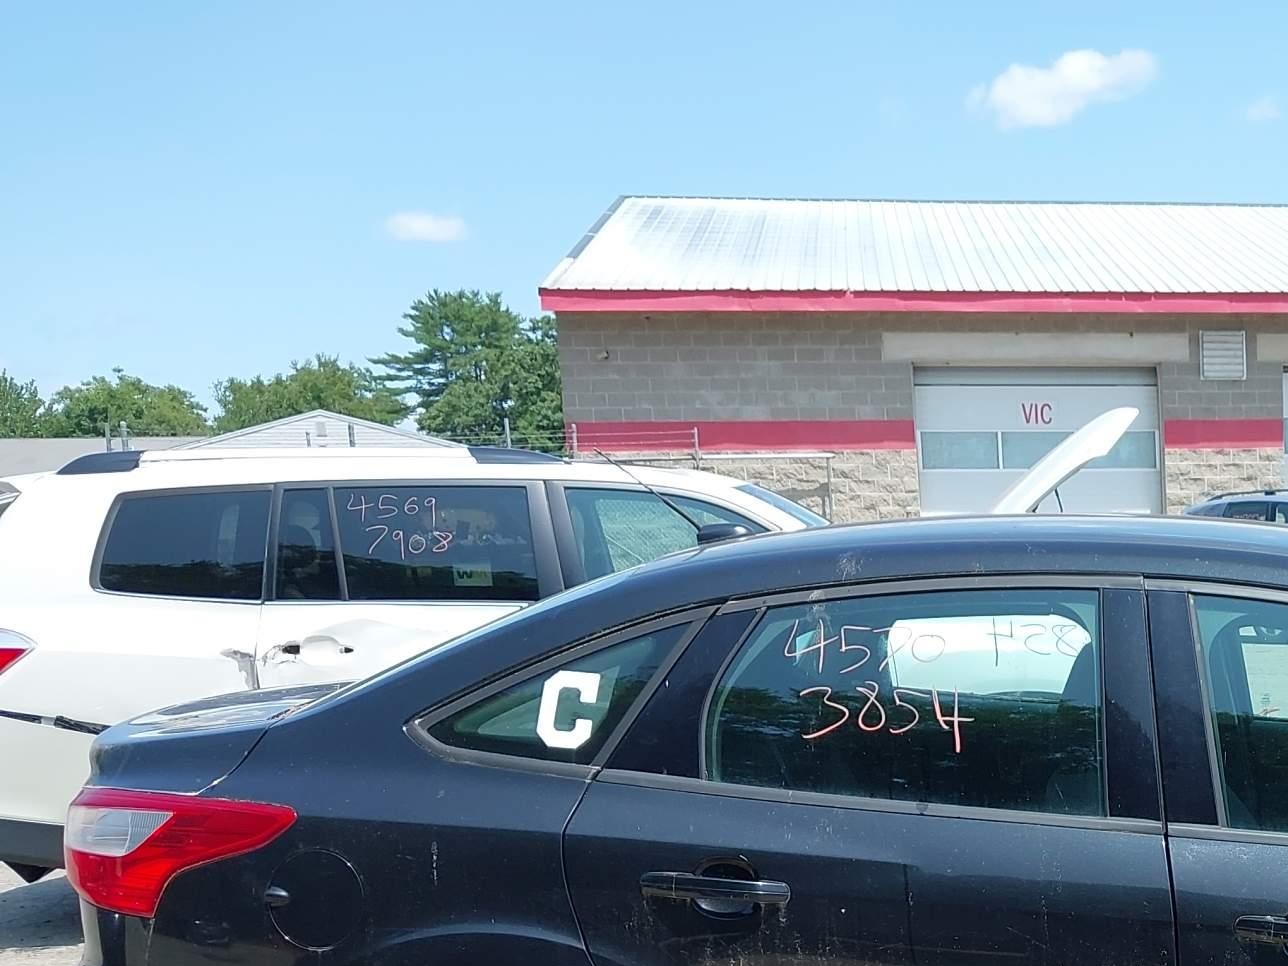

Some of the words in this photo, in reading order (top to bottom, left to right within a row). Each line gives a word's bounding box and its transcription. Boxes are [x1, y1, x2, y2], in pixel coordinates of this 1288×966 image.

[1021, 403, 1053, 425] VIC
[346, 493, 436, 528] 4569
[365, 525, 453, 560] 7908
[536, 670, 601, 749] C
[800, 680, 975, 754] 3854
